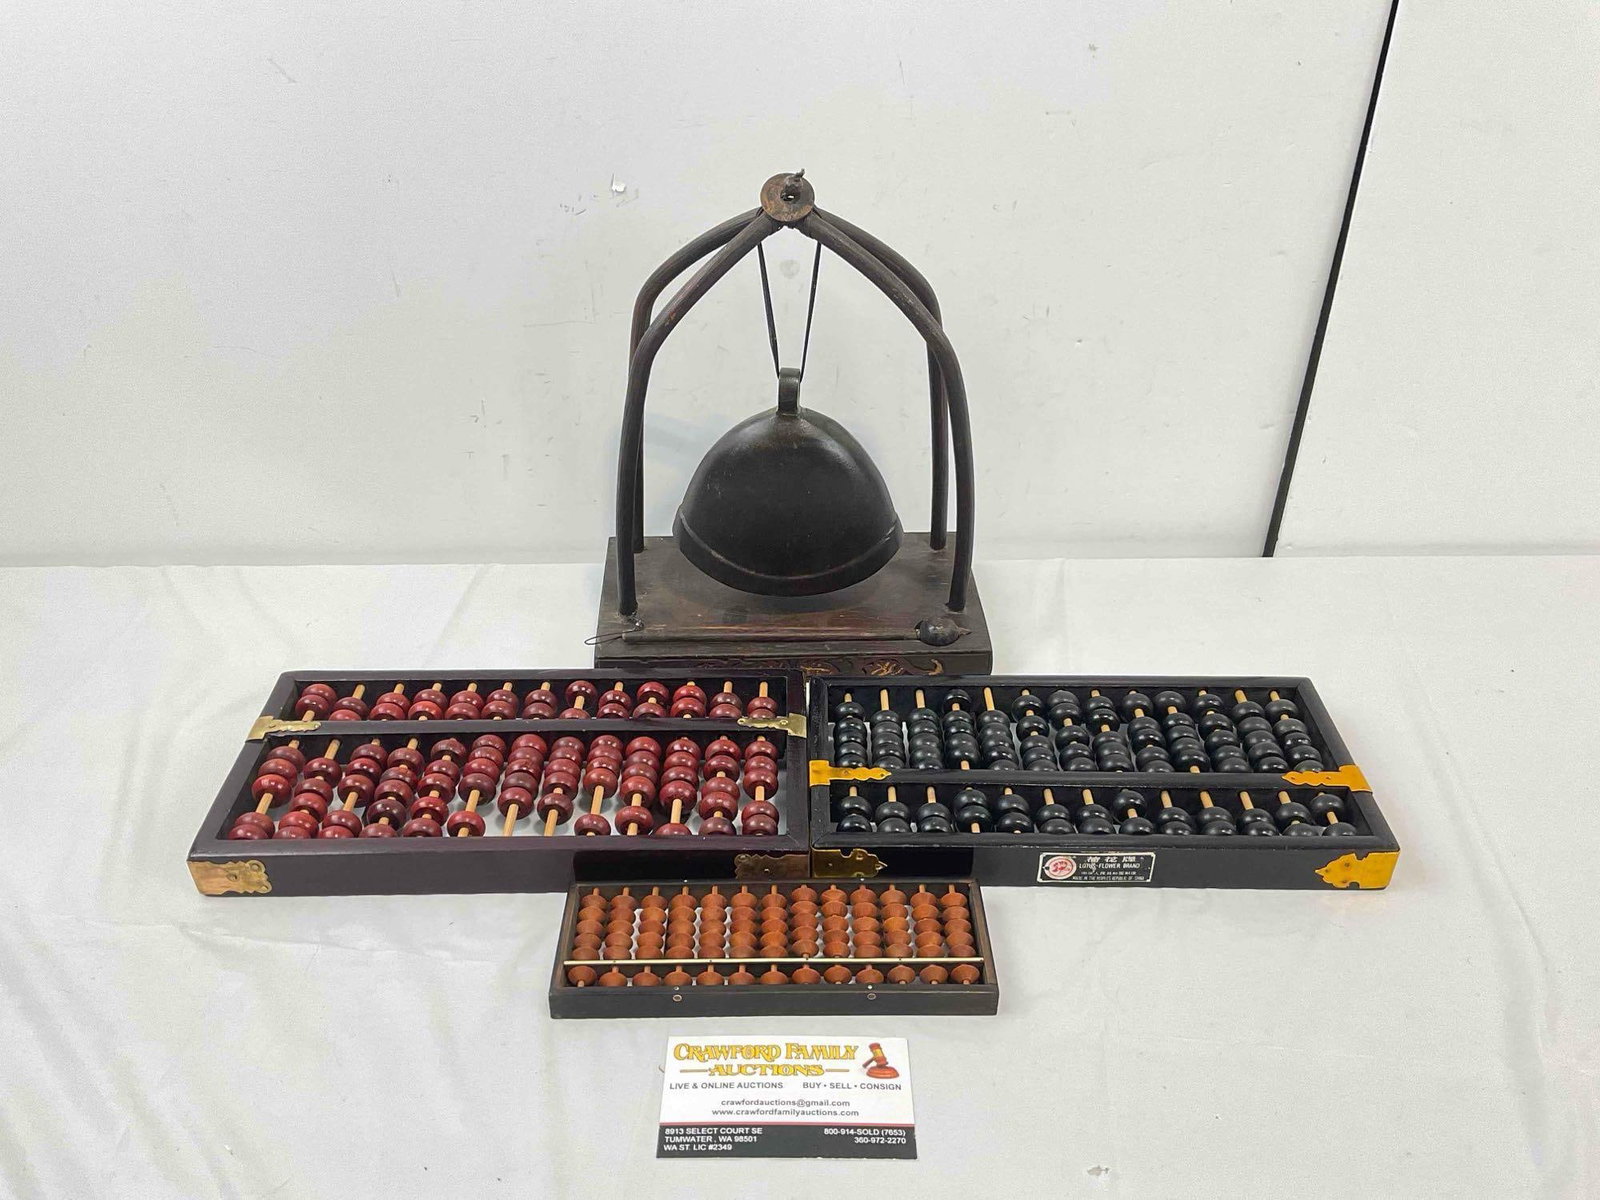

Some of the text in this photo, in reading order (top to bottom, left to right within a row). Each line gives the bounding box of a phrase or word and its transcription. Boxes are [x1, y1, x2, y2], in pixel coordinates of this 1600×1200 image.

[673, 1042, 859, 1063] CRAWFORD FAMILY
[708, 1064, 825, 1076] AUCTIONS
[701, 1082, 735, 1090] ONLINE
[829, 1082, 852, 1090] SELL
[859, 1082, 902, 1091] CONSIGN
[721, 1098, 851, 1108] crawfordauctions@gmail.com
[711, 1108, 860, 1117] www.crawfordfamilyauctions.com
[685, 1127, 718, 1135] SELECT
[719, 1127, 750, 1135] COURT
[751, 1127, 763, 1135] SE
[823, 1128, 879, 1136] 800-914-SOLD
[664, 1135, 713, 1143] TUMWATER
[718, 1135, 733, 1143] WA
[733, 1135, 757, 1143] 98501
[693, 1143, 707, 1151] LIC
